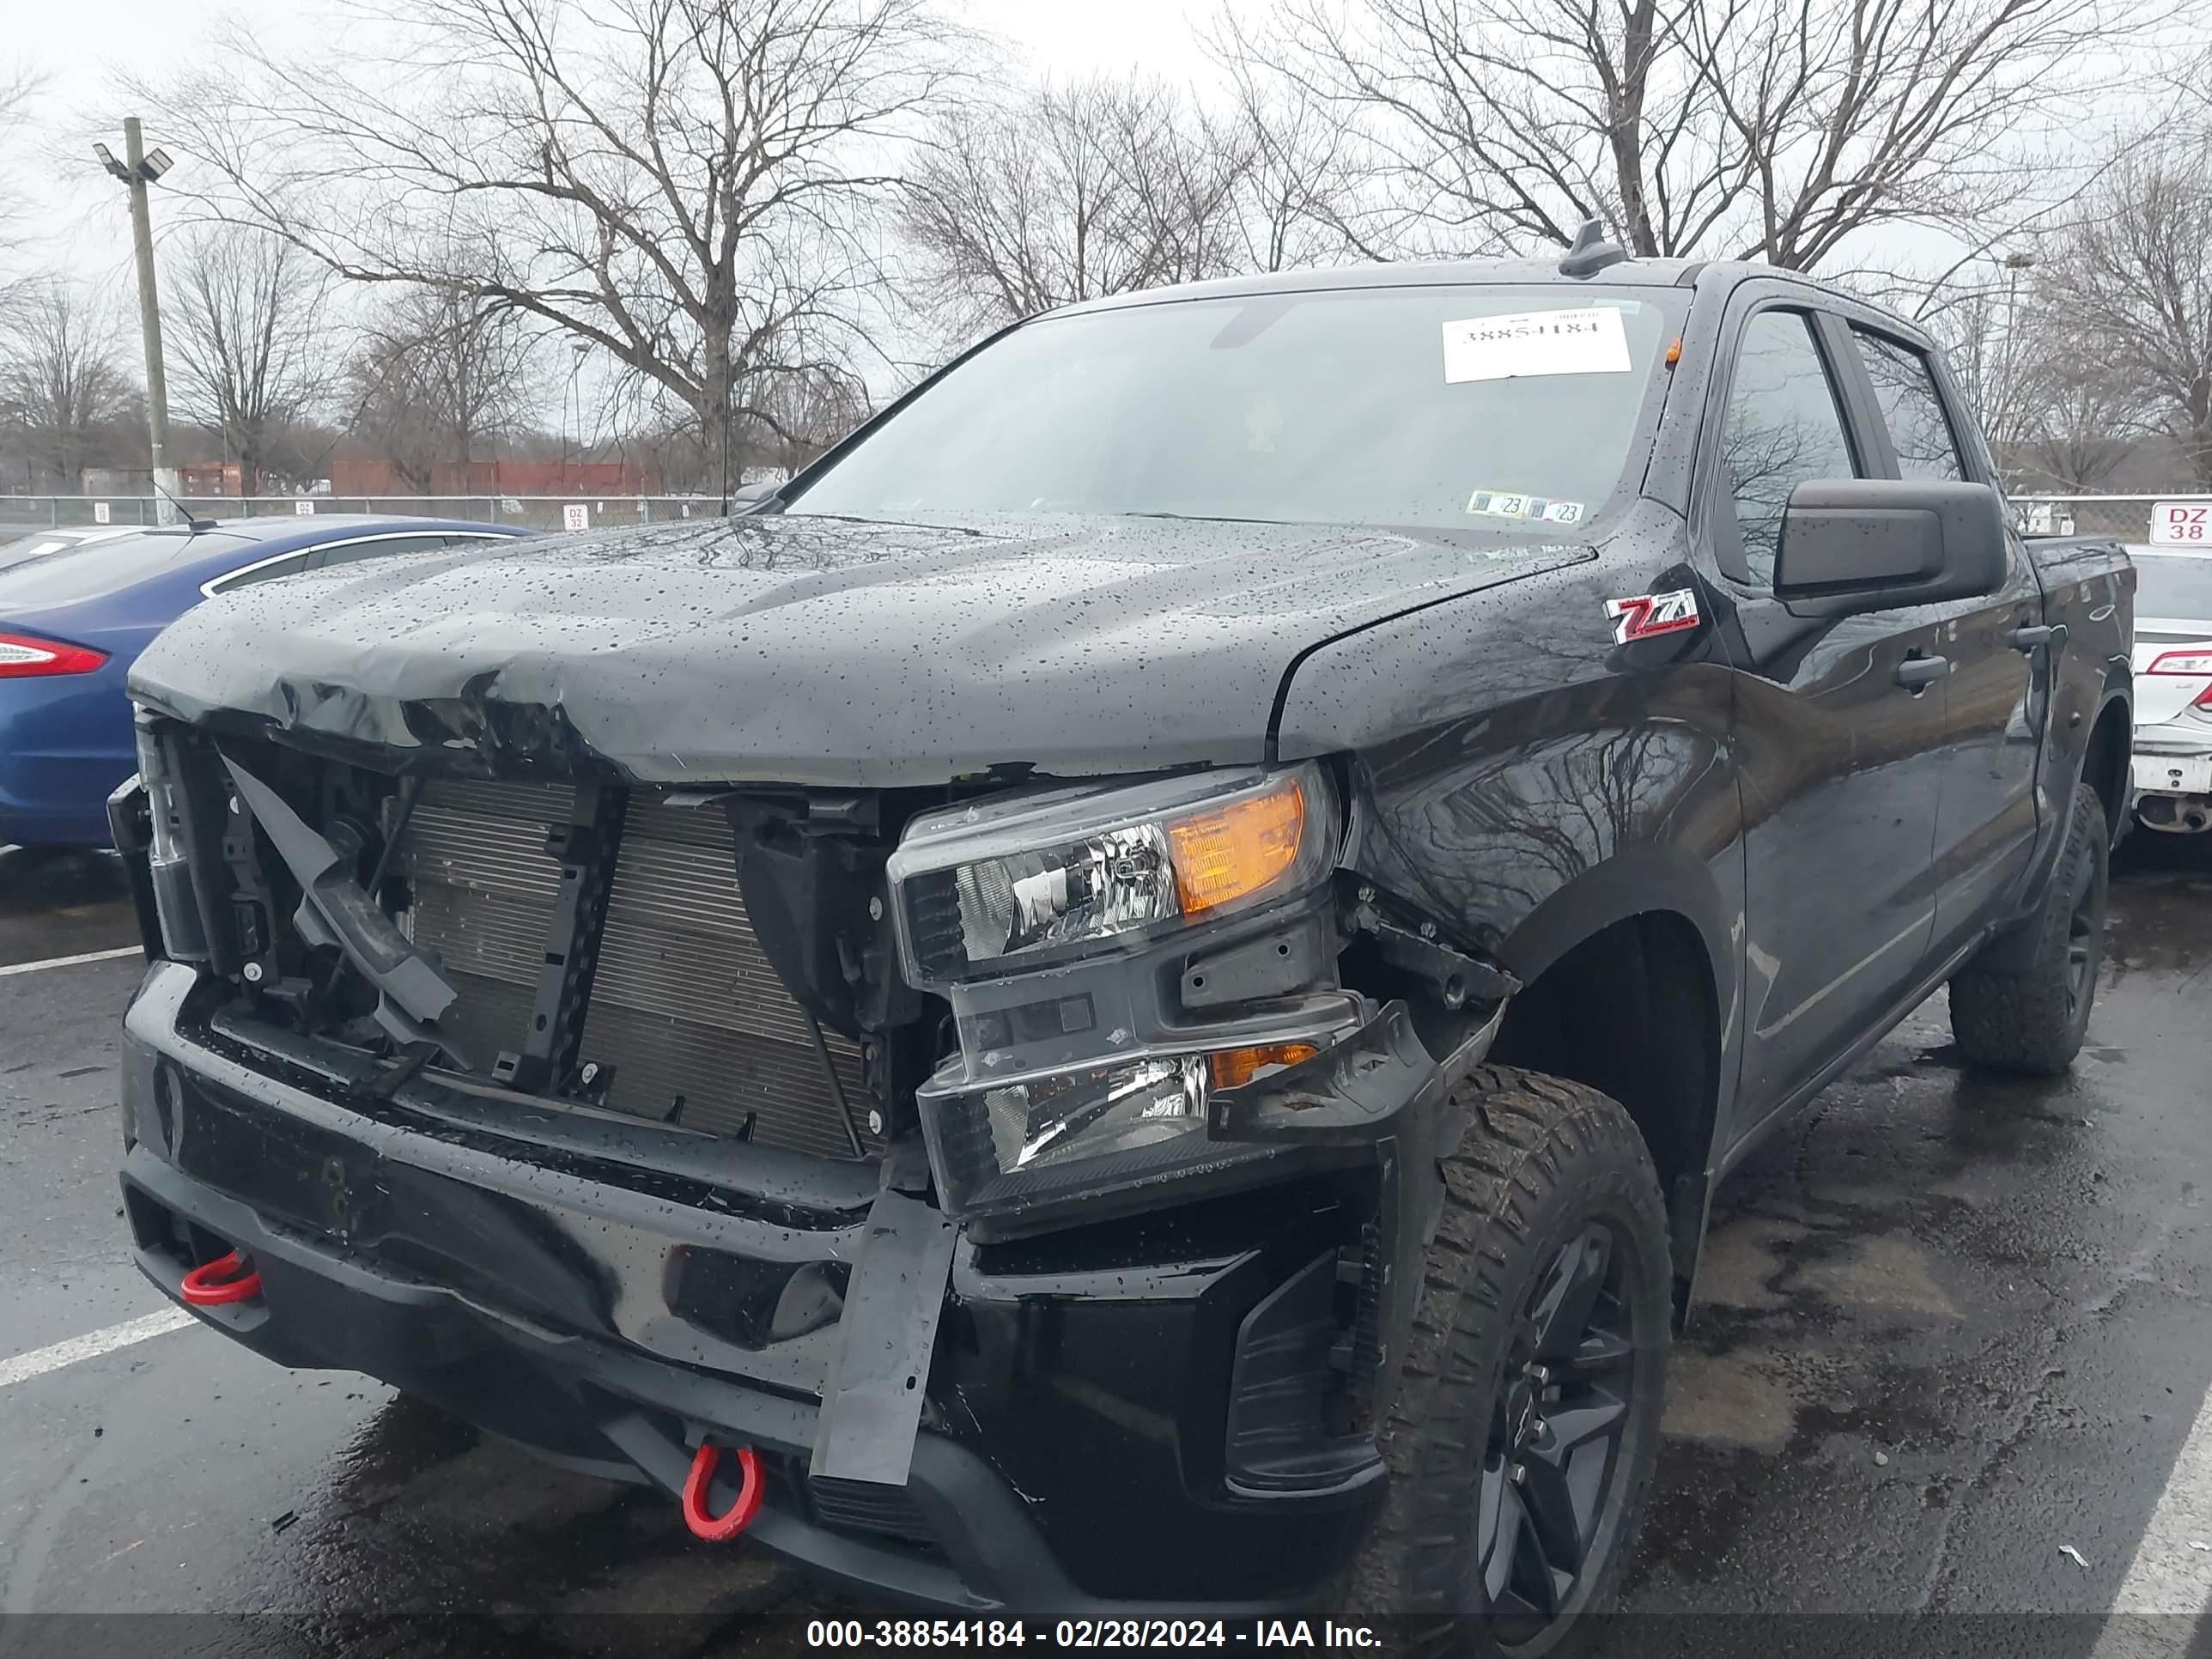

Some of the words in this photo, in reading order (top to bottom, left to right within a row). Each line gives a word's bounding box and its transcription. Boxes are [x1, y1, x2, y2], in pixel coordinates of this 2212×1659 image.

[569, 508, 582, 518] DZ
[1503, 497, 1522, 514] 23
[1559, 504, 1577, 521] 23
[571, 519, 582, 527] 32
[2170, 508, 2208, 523] DZ
[2170, 525, 2203, 539] 38
[1603, 587, 1699, 646] Z71
